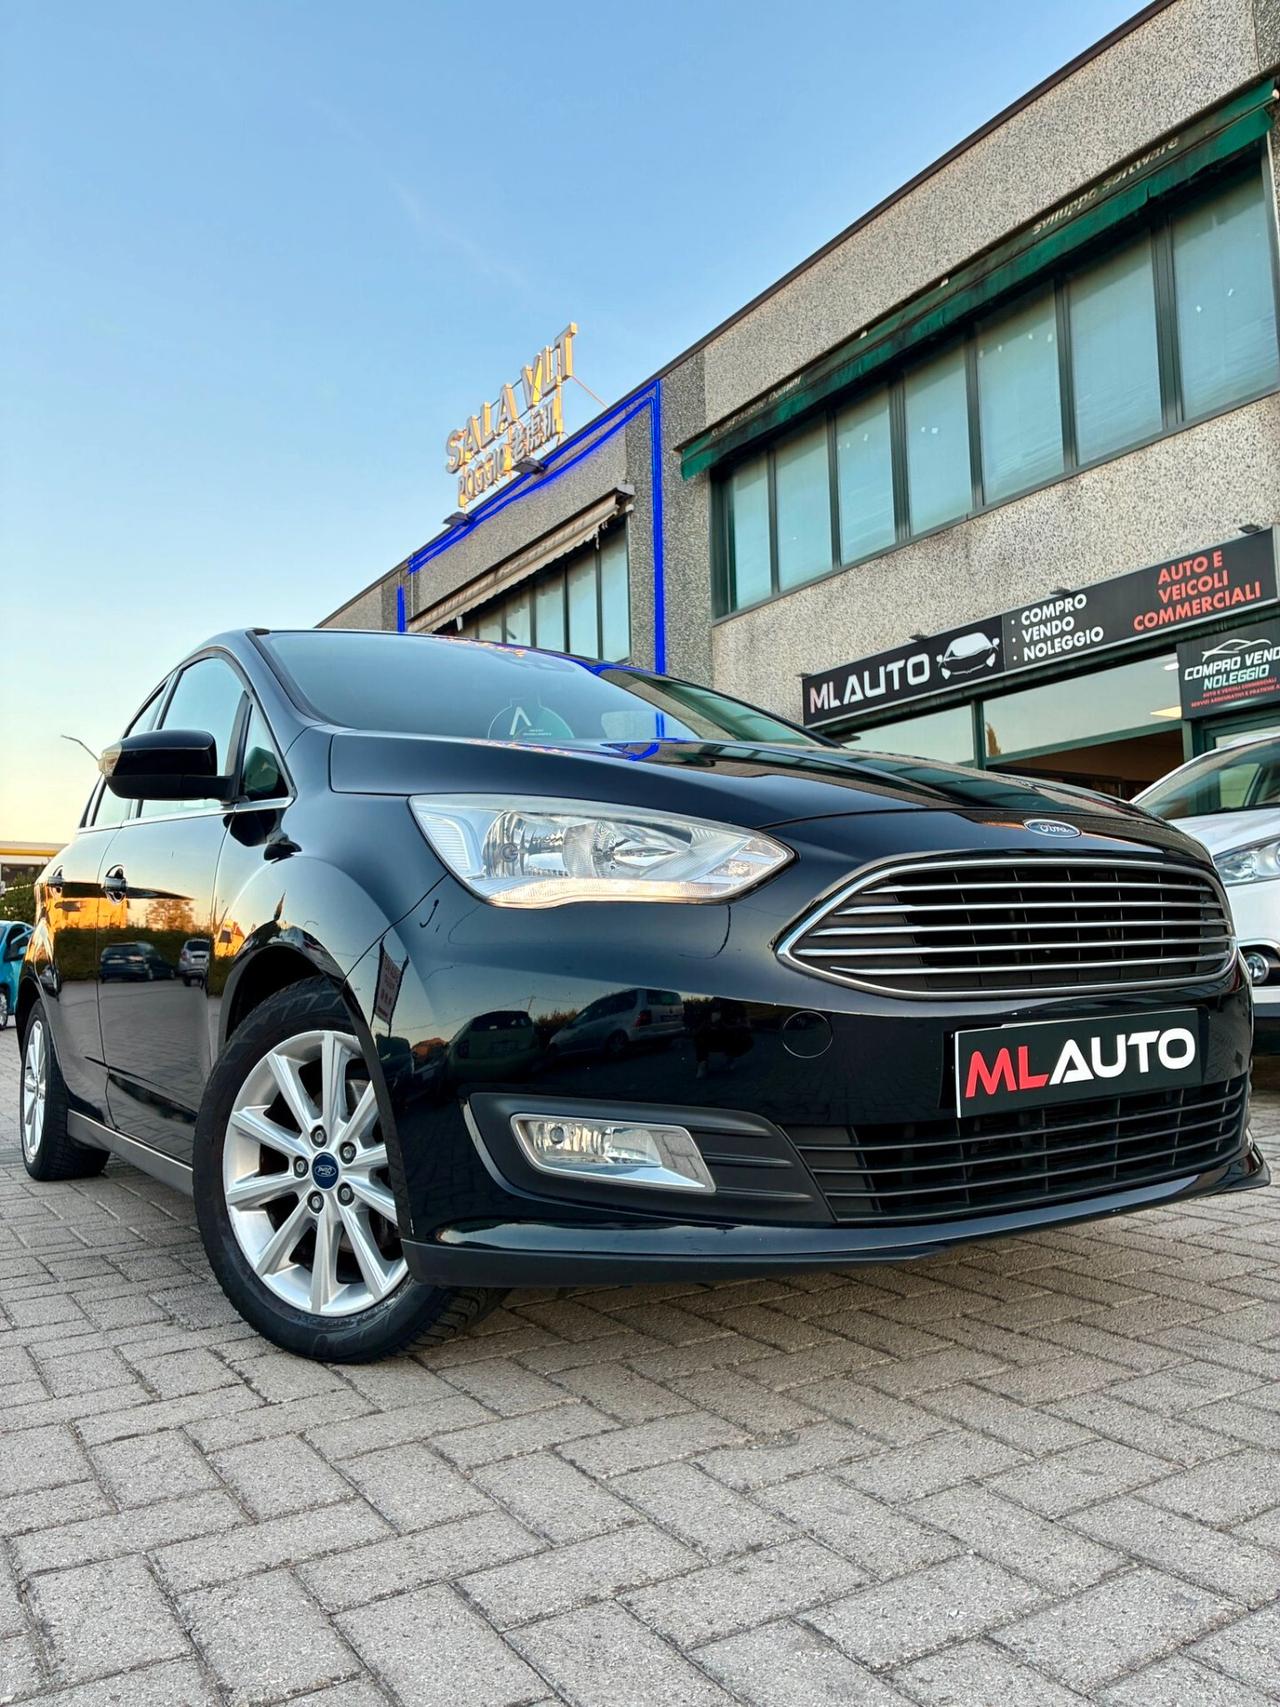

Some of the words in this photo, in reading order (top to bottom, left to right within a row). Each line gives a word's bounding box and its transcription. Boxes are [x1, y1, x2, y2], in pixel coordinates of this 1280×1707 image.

[446, 382, 519, 474] SALA
[1157, 556, 1208, 585] AUTO
[1213, 550, 1223, 568] E
[1157, 570, 1228, 604] VEICOLI
[1021, 594, 1087, 627] COMPRO
[1133, 581, 1261, 632] COMMERCIALI
[1022, 616, 1075, 643] VENDO
[1023, 626, 1104, 662] NOLEGGIO
[1184, 656, 1241, 681] COMPRO
[1203, 664, 1270, 690] NOLEGGIO
[965, 1027, 1196, 1098] MLAUTO
